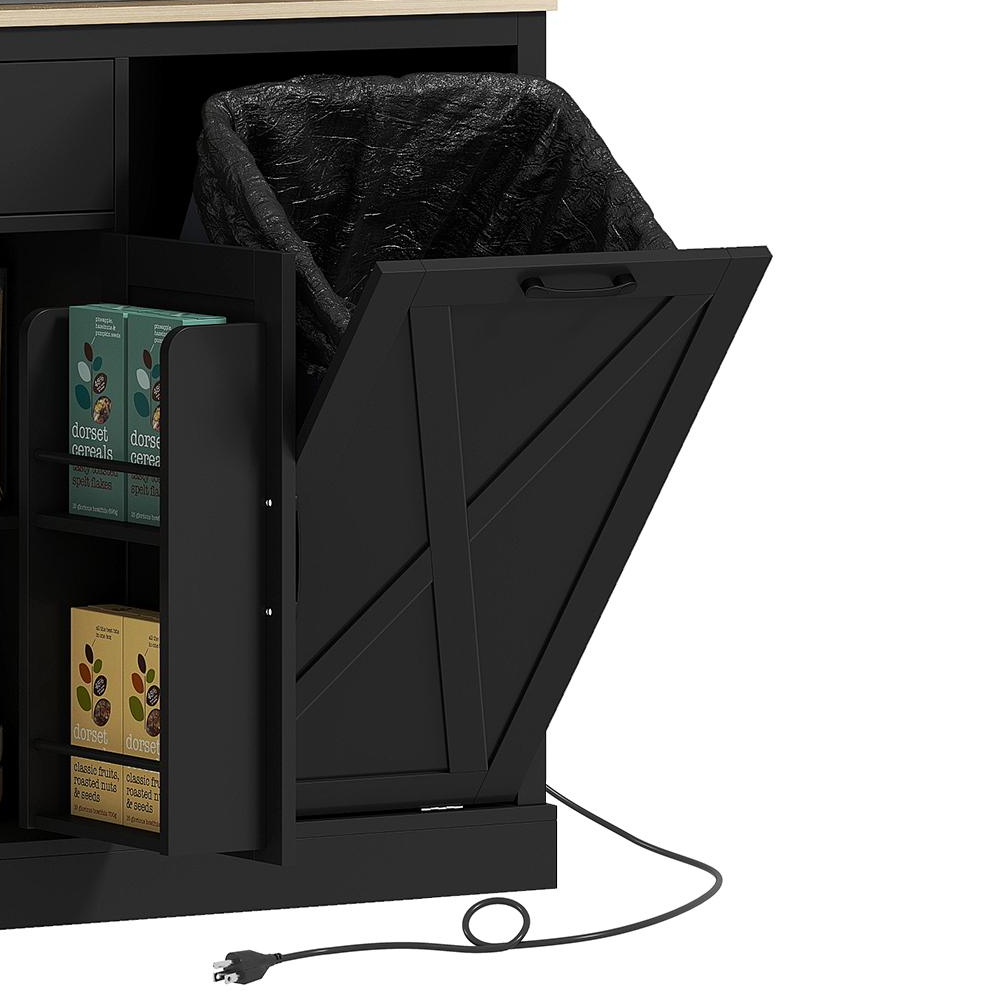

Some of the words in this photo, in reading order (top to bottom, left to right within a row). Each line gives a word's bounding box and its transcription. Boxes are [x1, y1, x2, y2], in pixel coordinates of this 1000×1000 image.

[72, 422, 109, 442] dorset
[72, 444, 113, 461] cereals
[72, 476, 90, 488] spelt
[73, 724, 108, 745] dorset
[74, 762, 97, 775] classic
[98, 766, 120, 782] fruits,
[126, 772, 150, 786] classic
[73, 776, 100, 789] roasted
[101, 782, 118, 793] nuts
[74, 787, 80, 799] &
[81, 790, 101, 803] seeds
[126, 787, 152, 800] roasted
[126, 798, 133, 809] &
[134, 801, 153, 813] seeds
